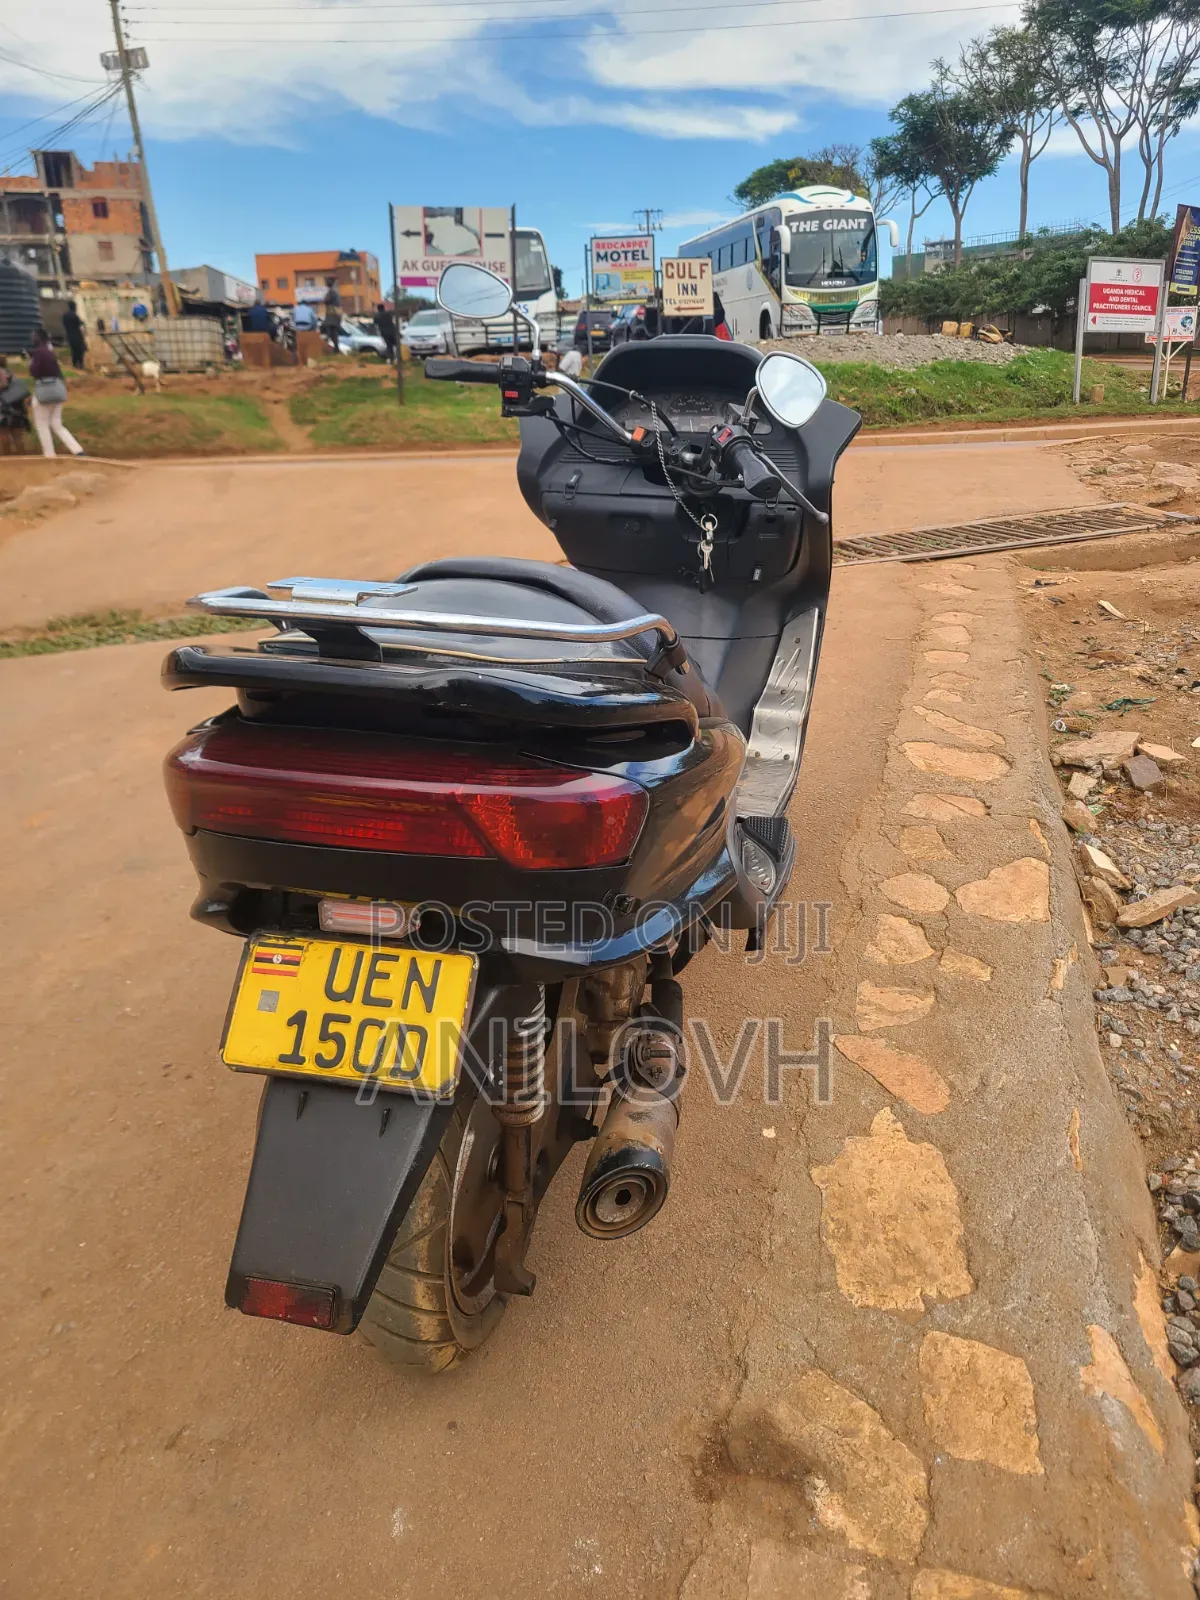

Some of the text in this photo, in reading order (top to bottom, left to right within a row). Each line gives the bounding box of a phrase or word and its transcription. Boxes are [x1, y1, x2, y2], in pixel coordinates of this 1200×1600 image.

[789, 218, 868, 233] THE GIANT
[595, 239, 649, 249] REDCARPET
[596, 249, 650, 262] MOTEL
[402, 260, 420, 271] AK
[665, 262, 709, 279] GULF
[677, 283, 698, 296] INN
[1093, 303, 1131, 311] PRACTITIONERS
[324, 947, 443, 1013] UEN
